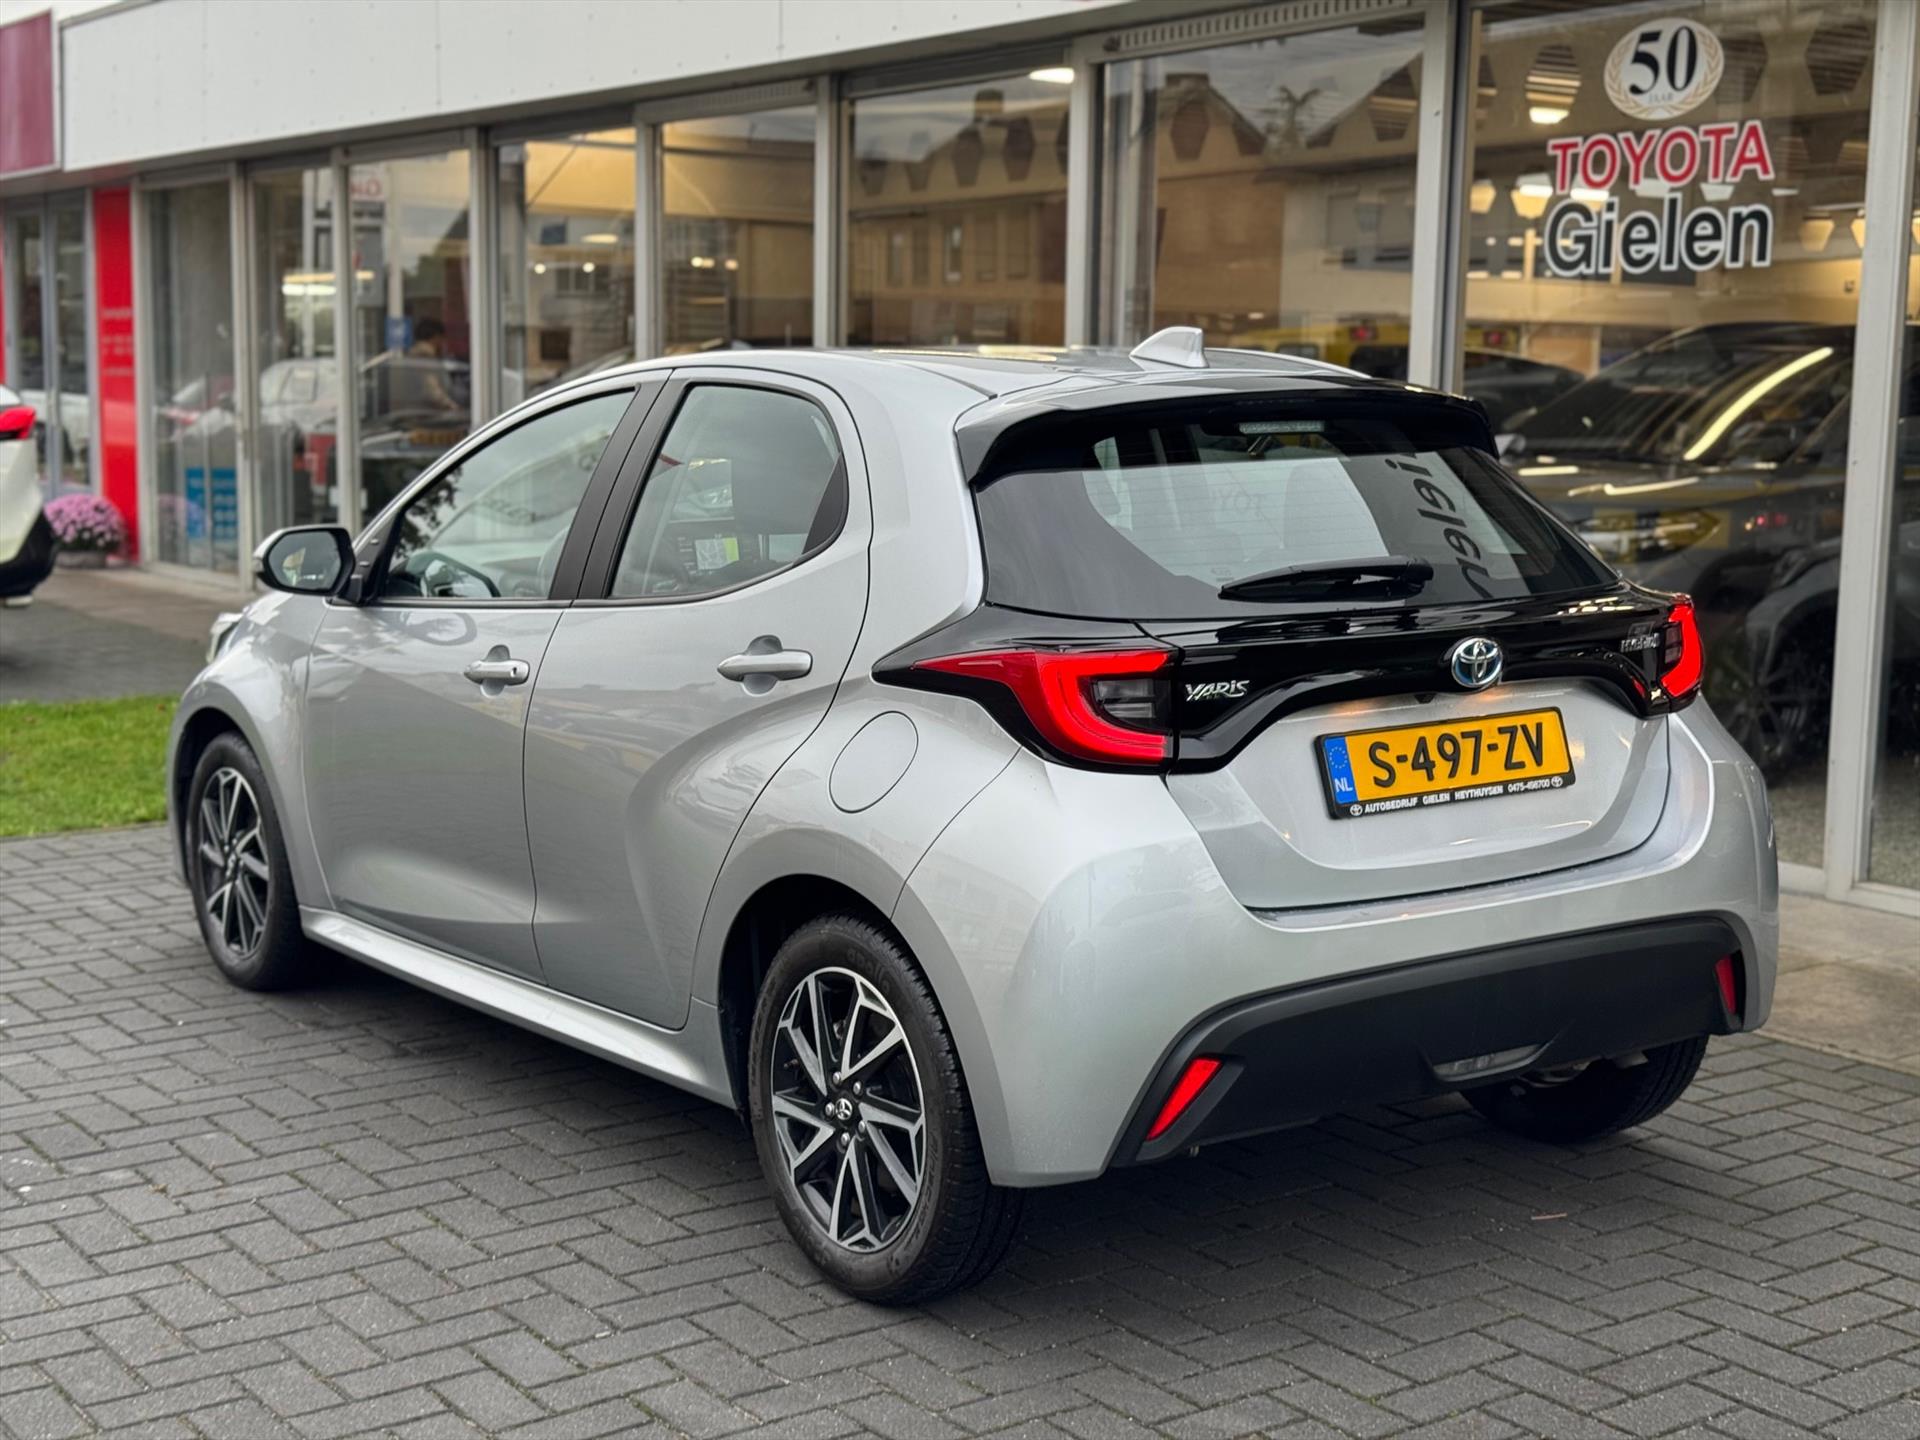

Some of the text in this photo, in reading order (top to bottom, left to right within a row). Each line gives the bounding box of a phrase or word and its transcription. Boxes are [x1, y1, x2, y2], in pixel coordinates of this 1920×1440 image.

[1629, 25, 1698, 96] 50
[1547, 120, 1775, 195] TOYOTA
[1544, 192, 1773, 277] Gielen
[1334, 776, 1353, 793] NL
[1368, 722, 1543, 788] S-497-ZV
[1364, 796, 1418, 814] AUTOBEDRIJF
[1422, 792, 1450, 806] GIELEN
